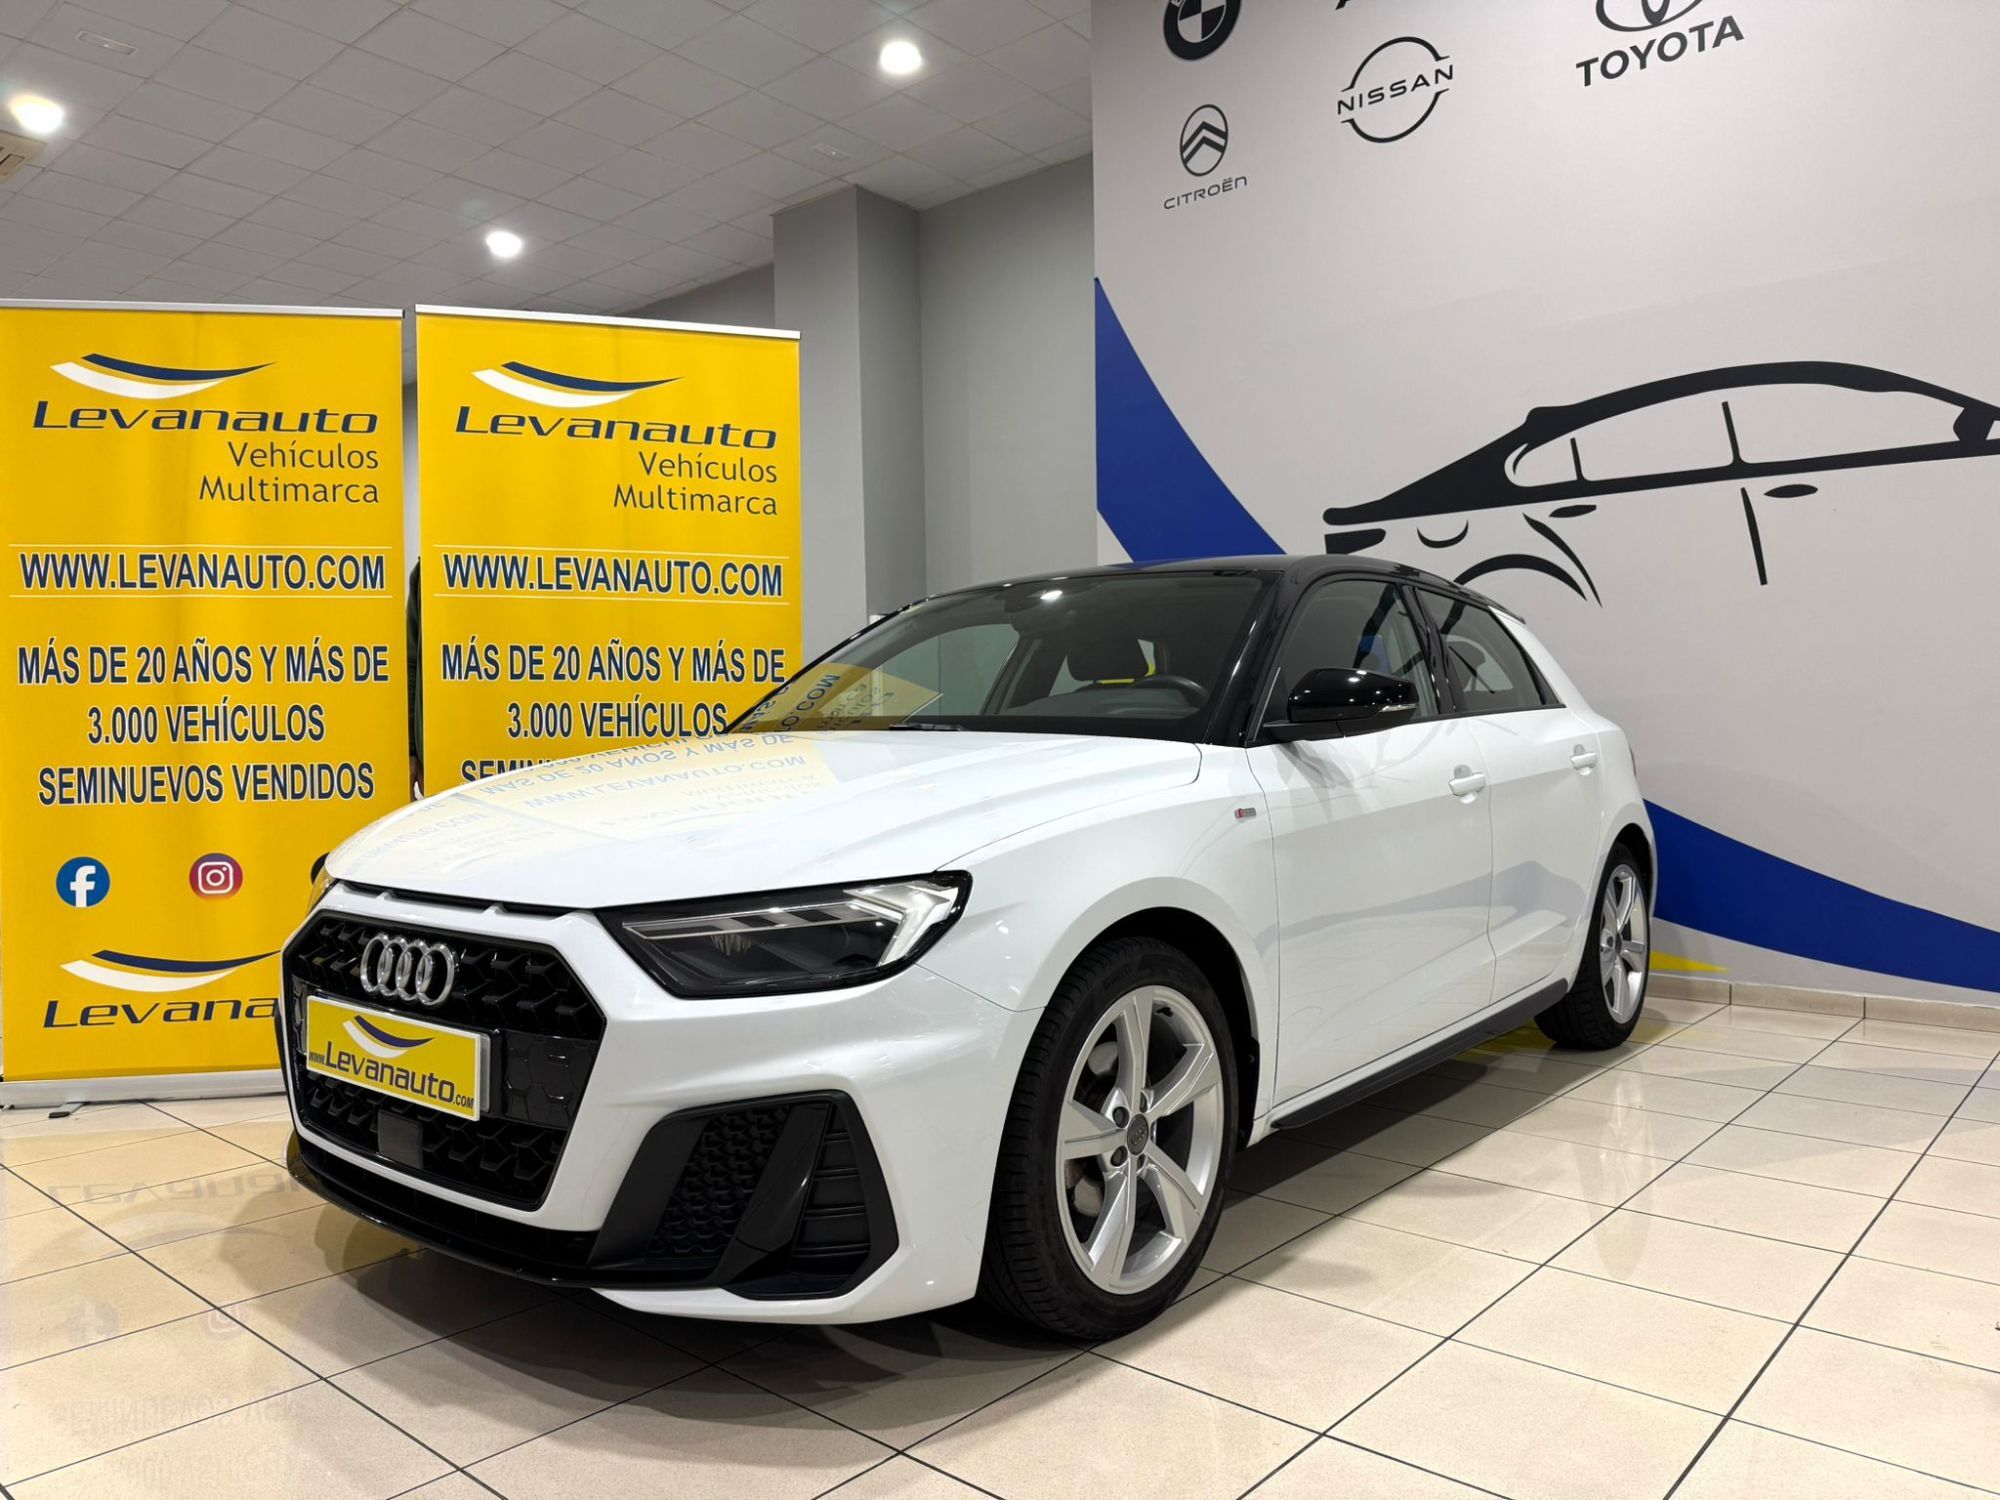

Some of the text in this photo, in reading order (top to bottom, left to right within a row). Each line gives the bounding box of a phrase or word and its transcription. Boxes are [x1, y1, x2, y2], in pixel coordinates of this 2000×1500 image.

[1576, 15, 1744, 87] TOYOTA
[1338, 64, 1453, 115] NISSAN
[33, 401, 378, 433] Levanauto
[455, 406, 777, 449] Levanauto
[228, 440, 379, 469] Vehículos
[638, 451, 777, 483] Vehículos
[199, 475, 379, 503] Multimarca
[613, 484, 777, 516] Multimarca
[20, 553, 385, 590] WWW.LEVANAUTO.COM
[443, 553, 782, 597] WWW.LEVANAUTO.COM
[18, 637, 389, 684] MÁS DE 20 AÑOS Y MÁS DE
[442, 636, 785, 683] MÁS DE 20 AÑOS Y MÁS DE
[88, 697, 325, 744] 3.000 VEHÍCULOS
[508, 702, 572, 738] 3.000
[580, 694, 728, 738] VEHÍCULOS
[38, 762, 374, 806] SEMINUEVOS VENDIDOS
